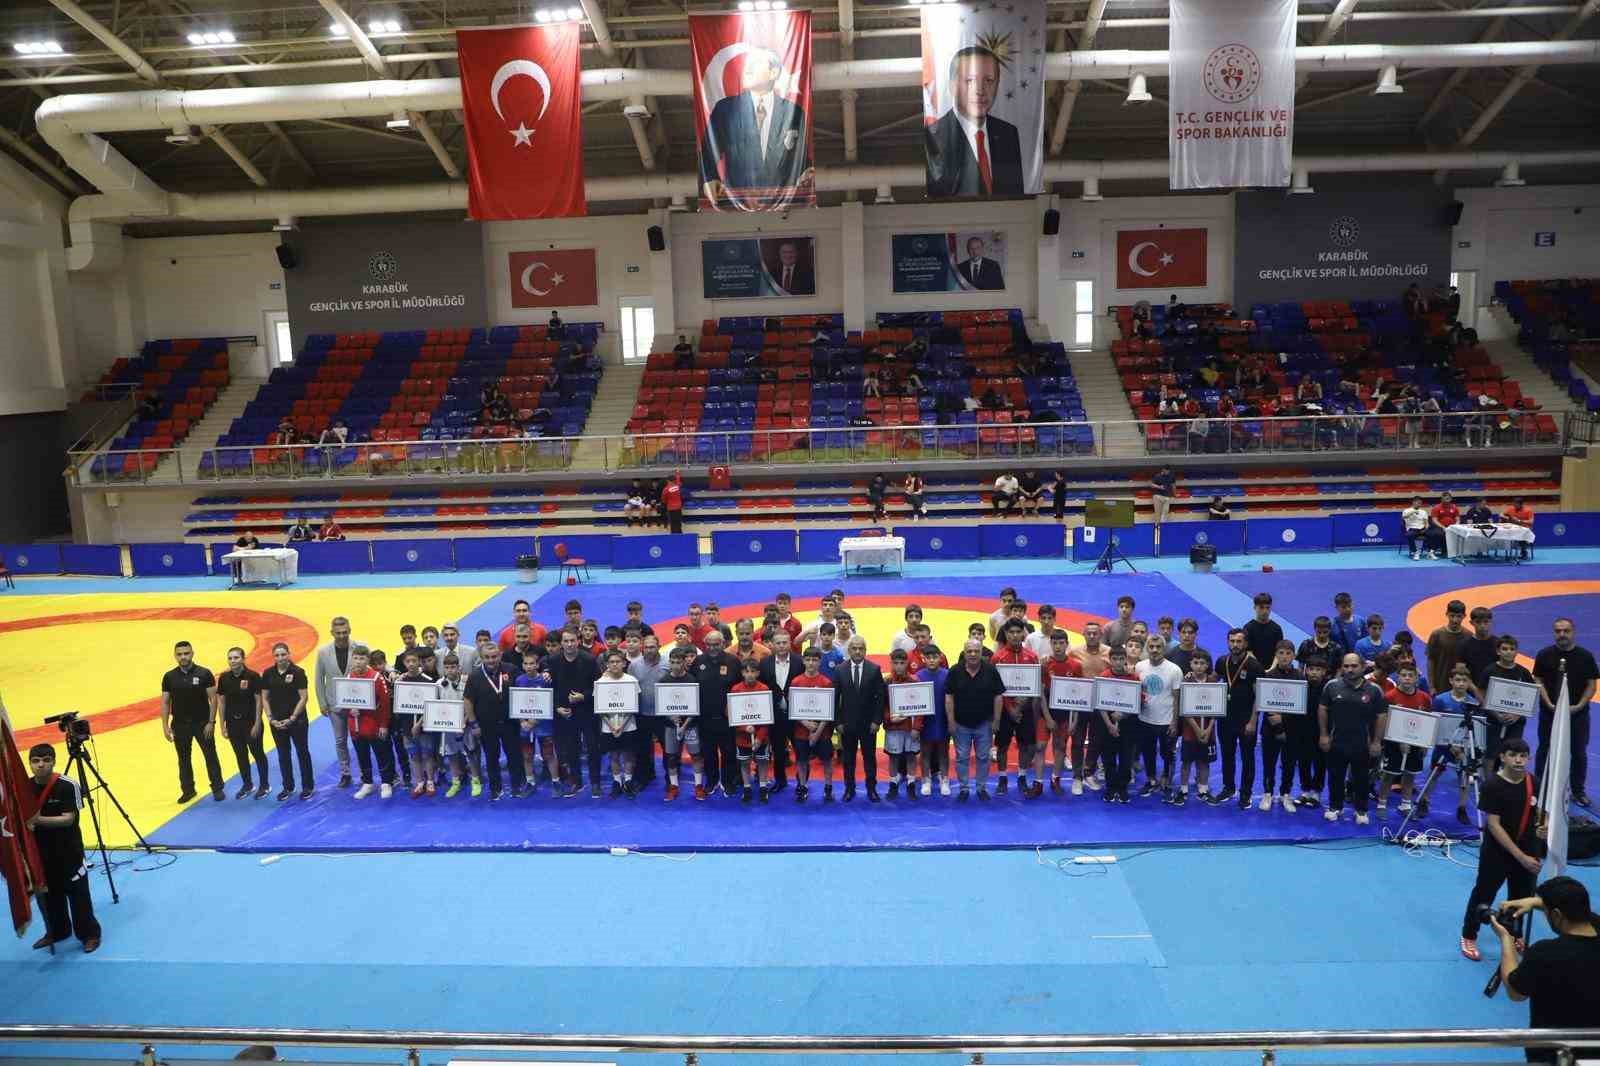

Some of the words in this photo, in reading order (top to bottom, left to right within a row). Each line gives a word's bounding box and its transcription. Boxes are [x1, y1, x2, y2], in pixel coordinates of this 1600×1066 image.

[1176, 112, 1200, 124] T.C.
[1270, 110, 1287, 121] VE
[1176, 127, 1211, 140] SPOR
[1214, 124, 1287, 138] BAKANLIĞI
[1539, 233, 1553, 245] E
[1318, 249, 1369, 262] KARABÜK
[1259, 266, 1303, 280] GENÇLİK
[1304, 268, 1317, 278] VE
[1319, 267, 1346, 278] SPOR
[1348, 265, 1359, 277] İL
[1360, 264, 1428, 277] MÜDÜRLÜĞÜ
[362, 282, 409, 294] KARABÜK
[310, 297, 350, 313] GENÇLİK
[351, 301, 364, 311] VE
[366, 299, 391, 310] SPOR
[392, 296, 401, 309] İL
[402, 295, 465, 308] MÜDÜRLÜĞÜ
